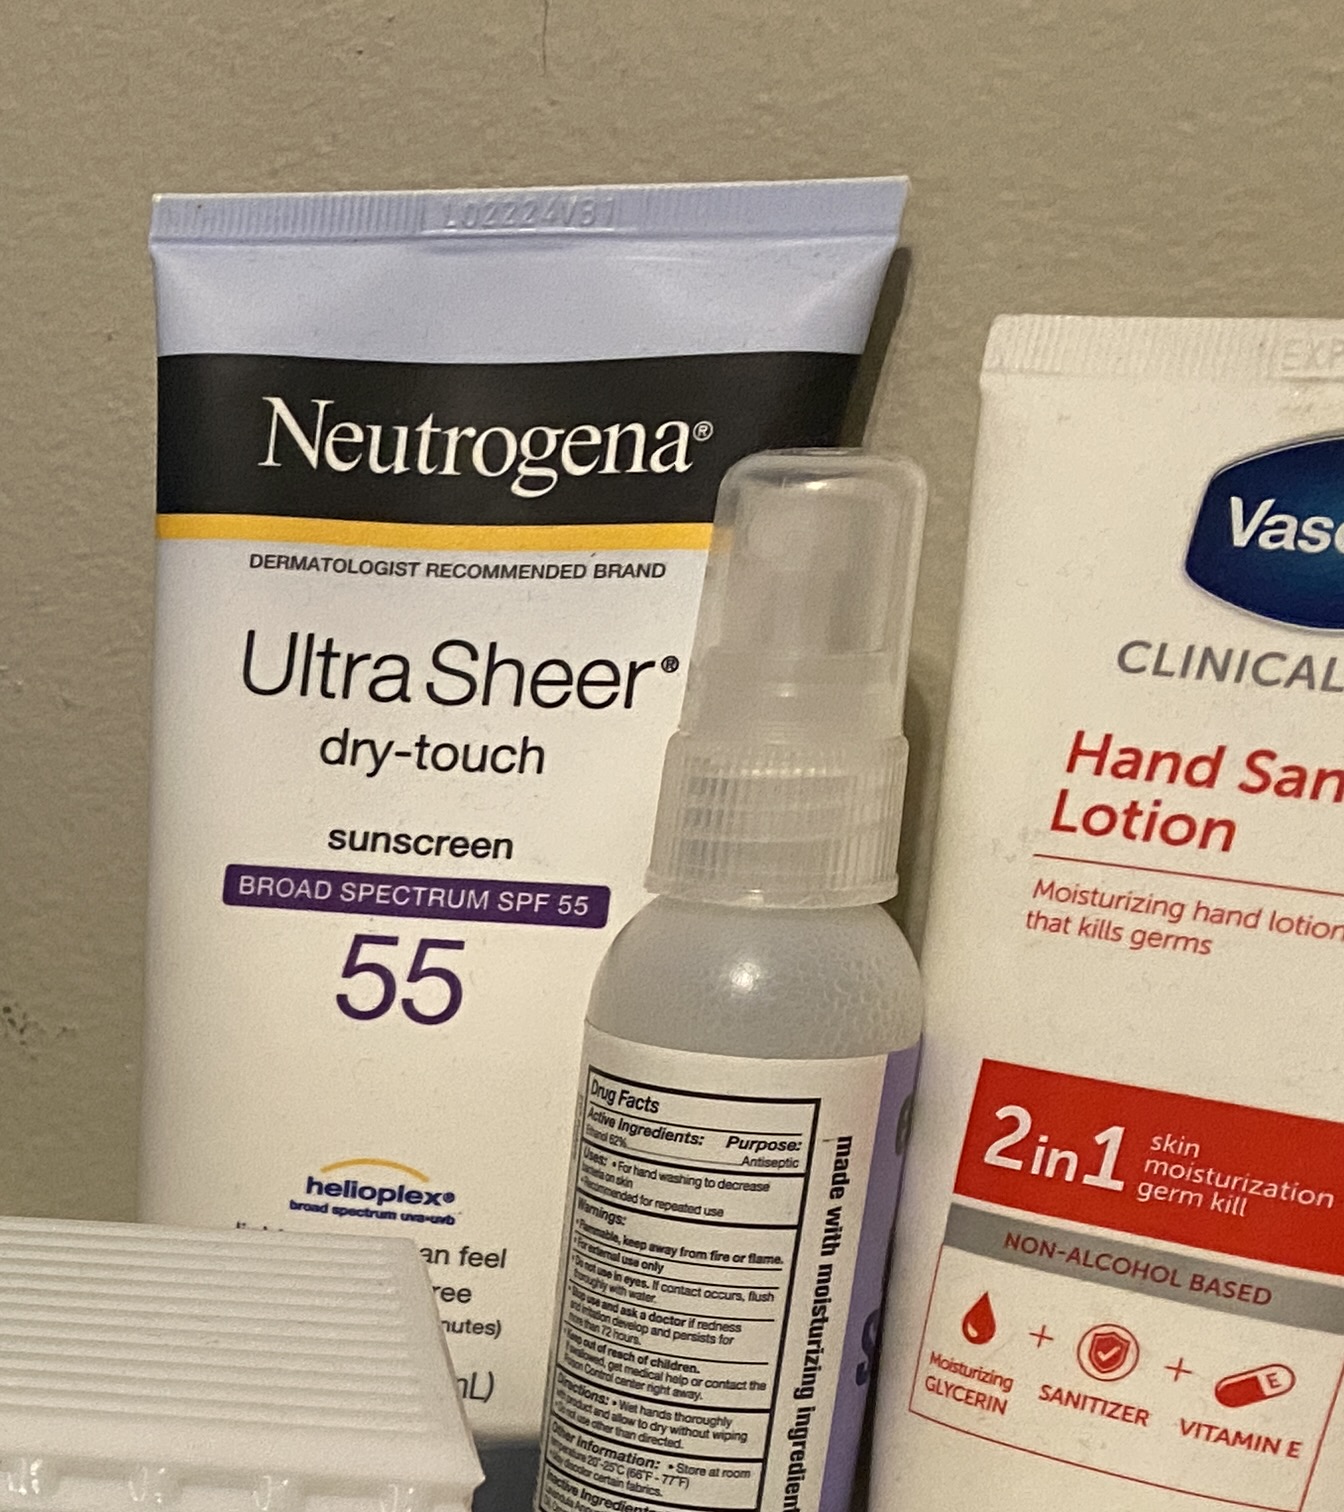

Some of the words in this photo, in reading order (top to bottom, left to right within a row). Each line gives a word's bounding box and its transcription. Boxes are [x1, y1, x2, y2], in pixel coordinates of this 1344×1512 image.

[250, 553, 419, 577] DERMATOLOGIST
[426, 562, 587, 580] RECOMMENDED
[594, 563, 666, 579] BRAND
[242, 630, 411, 703] Ultra
[1117, 640, 1344, 692] CLINICAL
[319, 729, 545, 777] dry-touch
[1066, 730, 1227, 789] Hand
[1238, 749, 1344, 803] San
[1050, 788, 1237, 853] Lotion
[328, 827, 513, 859] sunscreen
[239, 875, 332, 901] BROAD
[340, 883, 489, 911] SPECTRUM
[498, 891, 550, 913] SPF
[558, 895, 588, 916] 55
[1032, 878, 1185, 923] Moisturizing
[1192, 900, 1263, 929] hand
[1268, 910, 1344, 943] lotion
[1026, 910, 1072, 936] that
[1078, 917, 1124, 942] kills
[1129, 929, 1213, 956] germs
[335, 933, 465, 1025] 55
[591, 1079, 617, 1106] Drug
[618, 1089, 660, 1113] Facts
[587, 1106, 616, 1128] Active
[618, 1117, 705, 1146] Ingredients:
[725, 1135, 803, 1153] Purpose:
[1150, 1132, 1201, 1159] skin
[633, 1165, 658, 1180] hand
[704, 1177, 716, 1188] to
[717, 1179, 770, 1192] decrease
[741, 1155, 799, 1170] Antiseptic
[829, 1136, 853, 1200] made
[1137, 1181, 1204, 1208] germ
[1210, 1191, 1249, 1218] kill
[1144, 1158, 1336, 1209] moisturization
[289, 1199, 328, 1213] broad
[332, 1206, 396, 1220] spectrum
[655, 1200, 702, 1215] repeated
[703, 1207, 724, 1218] use
[623, 1235, 647, 1251] keep
[649, 1243, 678, 1258] away
[679, 1246, 708, 1260] from
[710, 1250, 730, 1262] fire
[732, 1254, 746, 1263] or
[820, 1206, 843, 1257] with
[459, 1246, 507, 1268] feel
[641, 1261, 664, 1275] only
[1004, 1232, 1182, 1288] NON-ALCOHOL
[1189, 1273, 1273, 1307] BASED
[661, 1283, 702, 1298] contact
[441, 1320, 501, 1339] nutes)
[620, 1306, 638, 1319] ask
[648, 1311, 687, 1327] doctor
[697, 1320, 742, 1333] redness
[793, 1263, 832, 1400] moisturizing
[718, 1334, 735, 1345] for
[607, 1348, 635, 1362] reach
[637, 1355, 649, 1365] of
[650, 1358, 700, 1374] children.
[929, 1351, 1014, 1394] Moisturizing
[691, 1379, 703, 1388] or
[704, 1379, 747, 1391] contact
[749, 1380, 767, 1391] the
[638, 1419, 648, 1429] to
[650, 1421, 668, 1435] dry
[670, 1426, 710, 1439] without
[712, 1430, 748, 1444] wiping
[639, 1406, 672, 1421] hands
[674, 1411, 733, 1429] thoroughly
[925, 1375, 1008, 1416] GLYCERIN
[1038, 1384, 1151, 1428] SANITIZER
[1179, 1418, 1283, 1457] VITAMIN
[1286, 1440, 1303, 1459] E
[576, 1436, 661, 1470] Information:
[676, 1462, 707, 1477] Store
[721, 1469, 751, 1480] room
